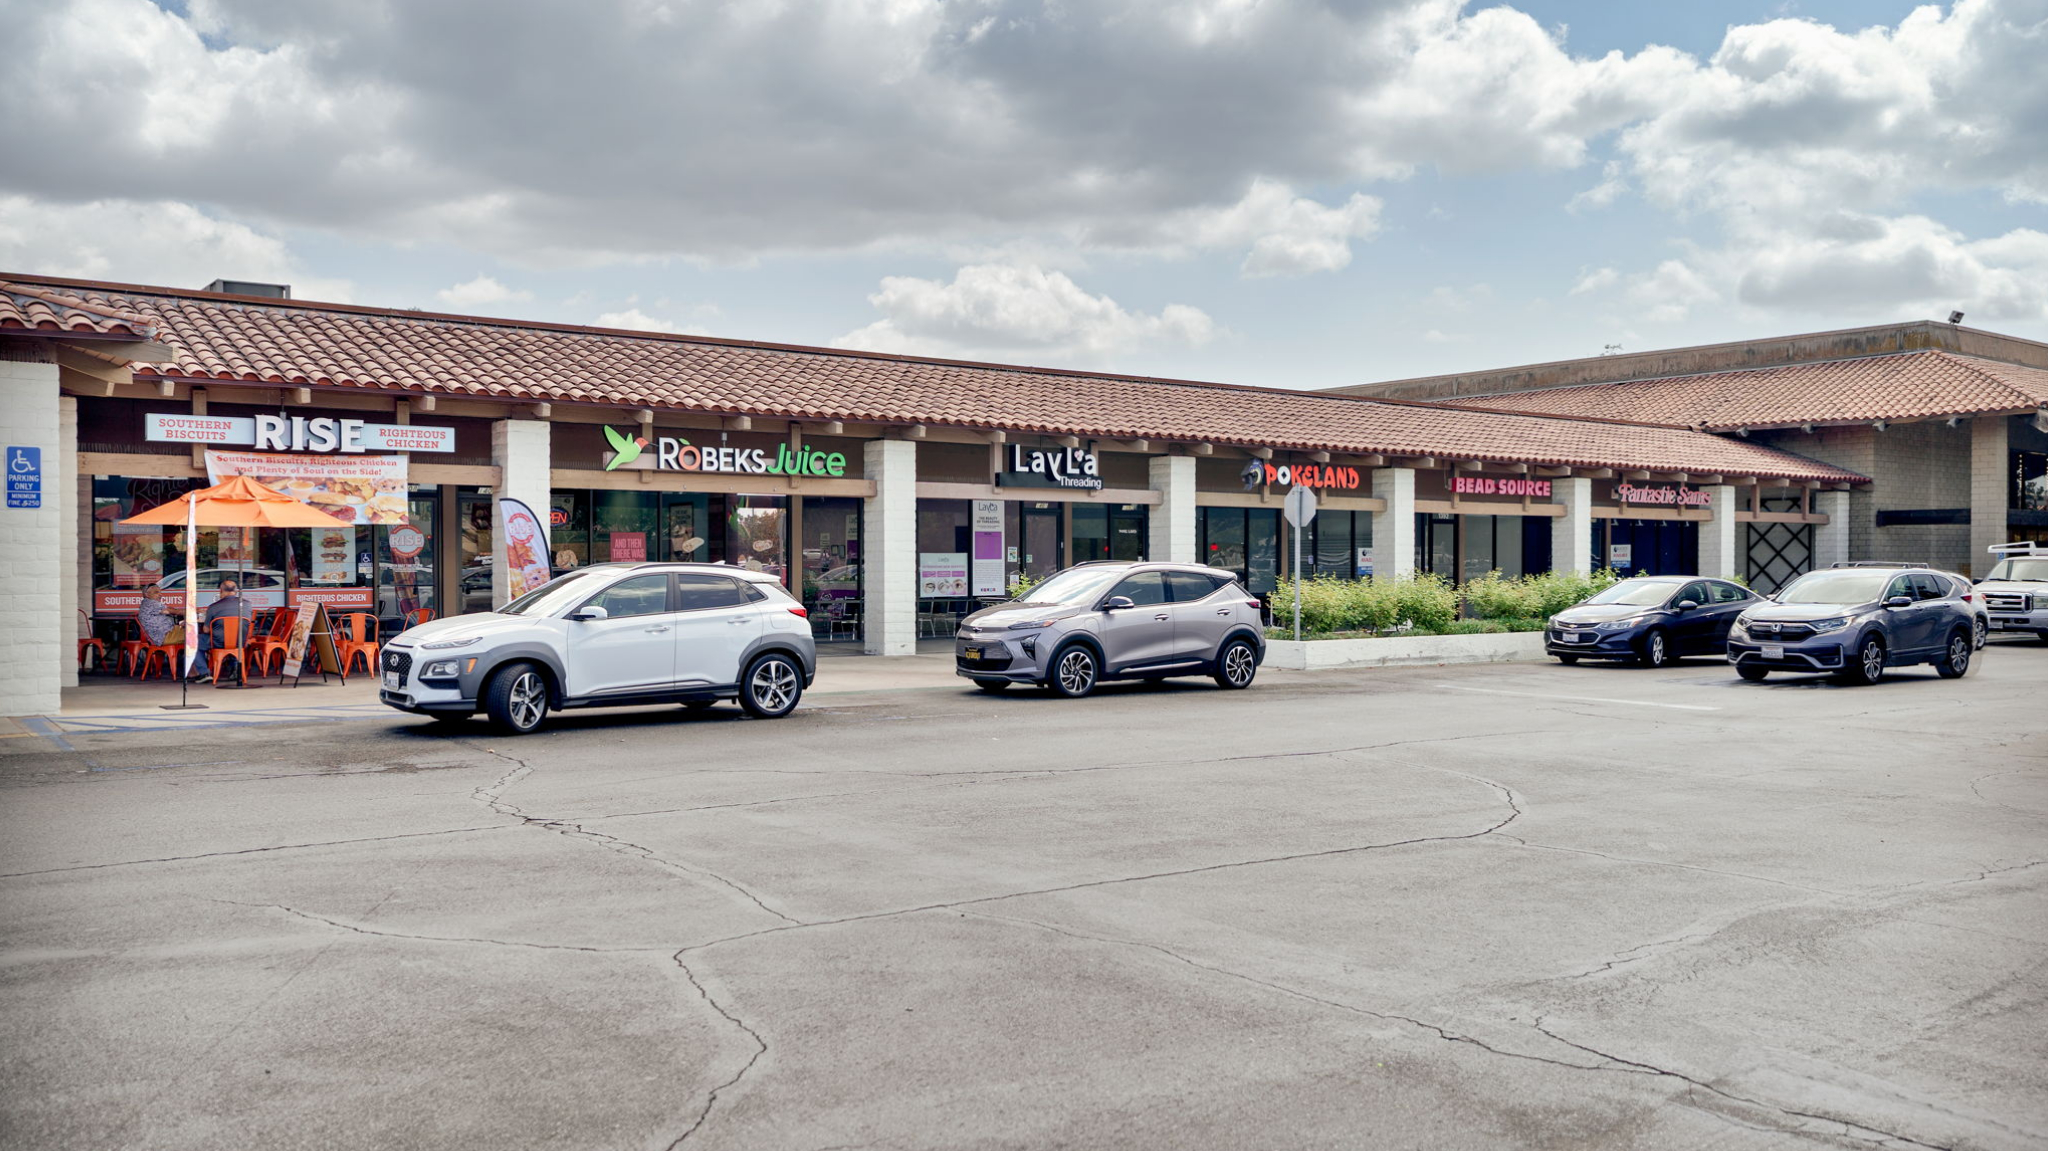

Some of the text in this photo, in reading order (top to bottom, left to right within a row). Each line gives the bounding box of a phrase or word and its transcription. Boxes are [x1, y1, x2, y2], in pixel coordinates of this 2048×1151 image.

[158, 418, 232, 430] SOUTHERN
[165, 429, 226, 440] BISCUITS
[255, 414, 366, 453] RISE
[379, 428, 446, 440] RIGHTEOUS
[386, 438, 440, 449] CHICKEN
[216, 454, 398, 467] Southern Biscuits, Righteous Chicken
[658, 437, 847, 476] ROBEKS Juice
[256, 466, 287, 474] Plenty
[302, 467, 325, 475] Soul
[359, 468, 382, 476] Side!
[1264, 462, 1360, 489] POKELAND
[8, 474, 40, 483] PARKING
[1060, 476, 1102, 490] Threading
[14, 482, 34, 490] ONLY
[1455, 476, 1552, 497] BEAD SOURCE
[1618, 483, 1713, 506] Fantastic Sams
[391, 534, 423, 547] RISE
[614, 538, 642, 549] AND THEN
[613, 548, 645, 559] THERE WAS
[296, 593, 367, 603] RIGHTEOUS CHICKEN
